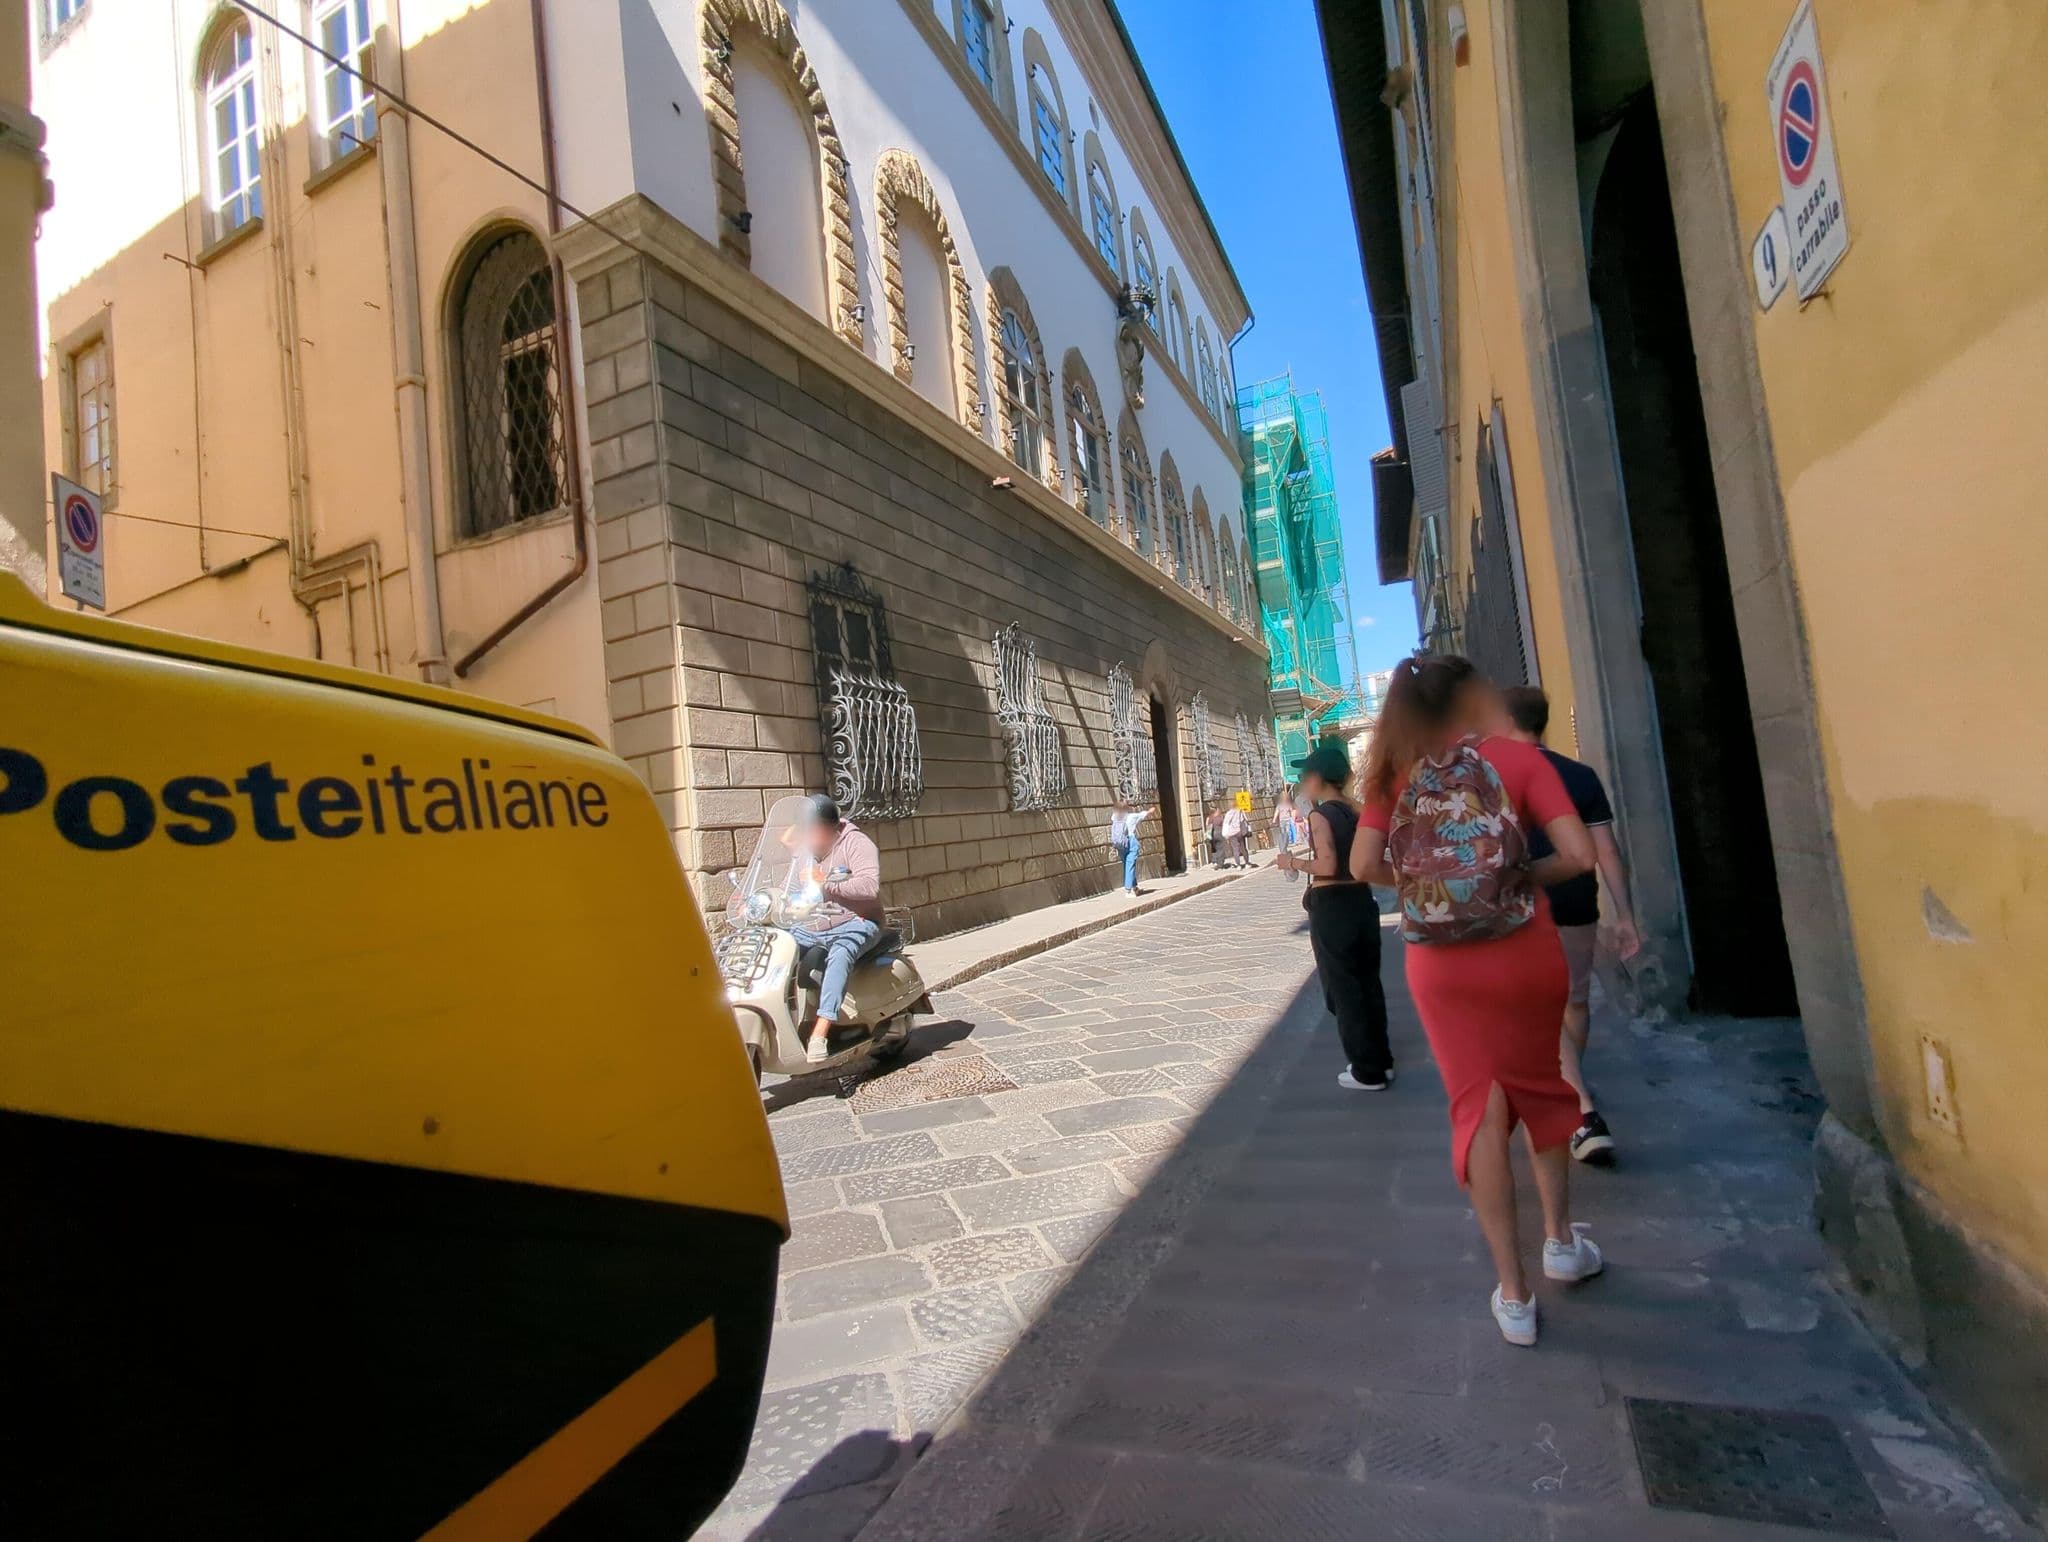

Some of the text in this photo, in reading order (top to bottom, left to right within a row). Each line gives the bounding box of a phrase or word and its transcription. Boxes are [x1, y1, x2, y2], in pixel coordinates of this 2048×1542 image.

[1796, 200, 1840, 272] carrabile
[1797, 178, 1826, 237] passo
[1763, 233, 1777, 289] 9
